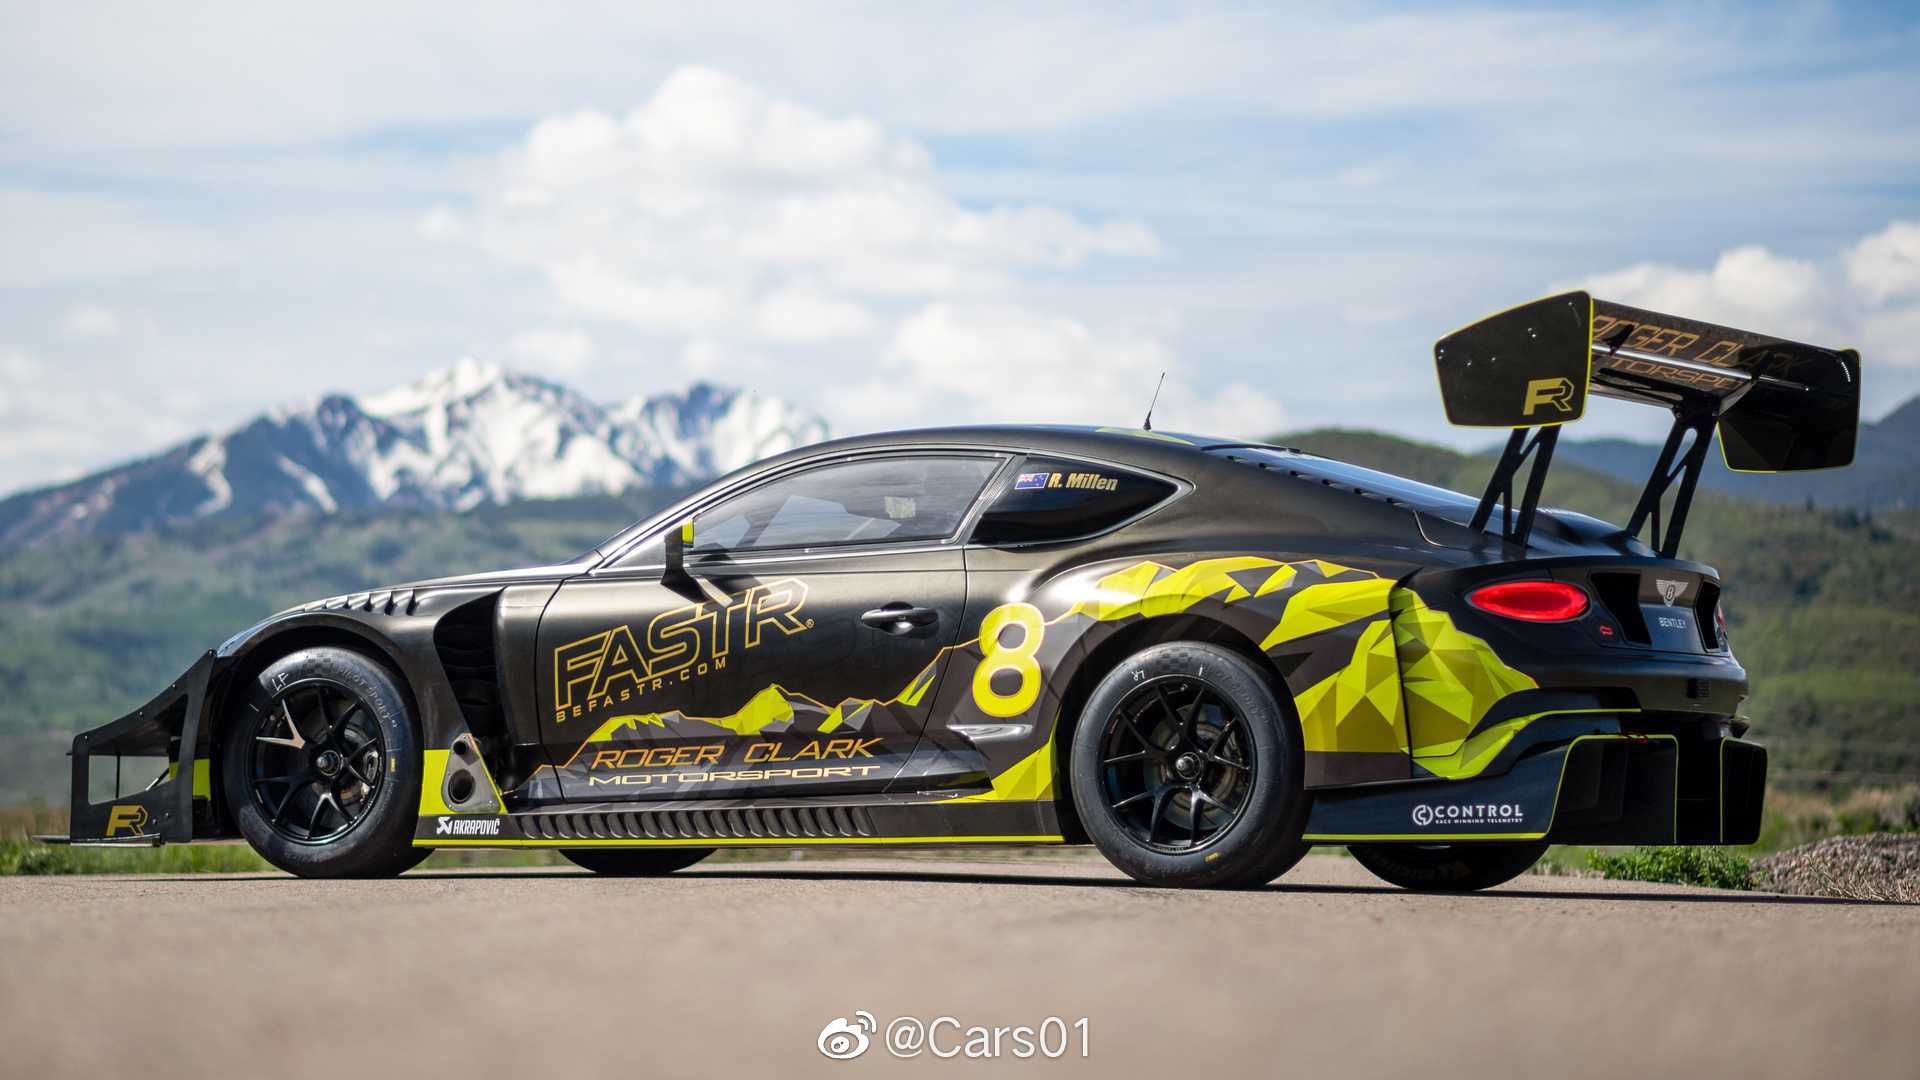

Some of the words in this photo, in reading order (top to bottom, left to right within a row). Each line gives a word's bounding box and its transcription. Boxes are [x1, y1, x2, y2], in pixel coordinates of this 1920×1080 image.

[1047, 473, 1063, 488] R.
[1065, 472, 1119, 491] Millen
[1658, 617, 1688, 629] BENTLEY
[972, 602, 1045, 718] 8
[556, 655, 728, 723] BEFASTR.COM
[591, 744, 726, 770] ROGER
[743, 737, 884, 764] CLARK
[588, 765, 881, 787] MOTORSPORT
[1434, 804, 1524, 818] CONTROL
